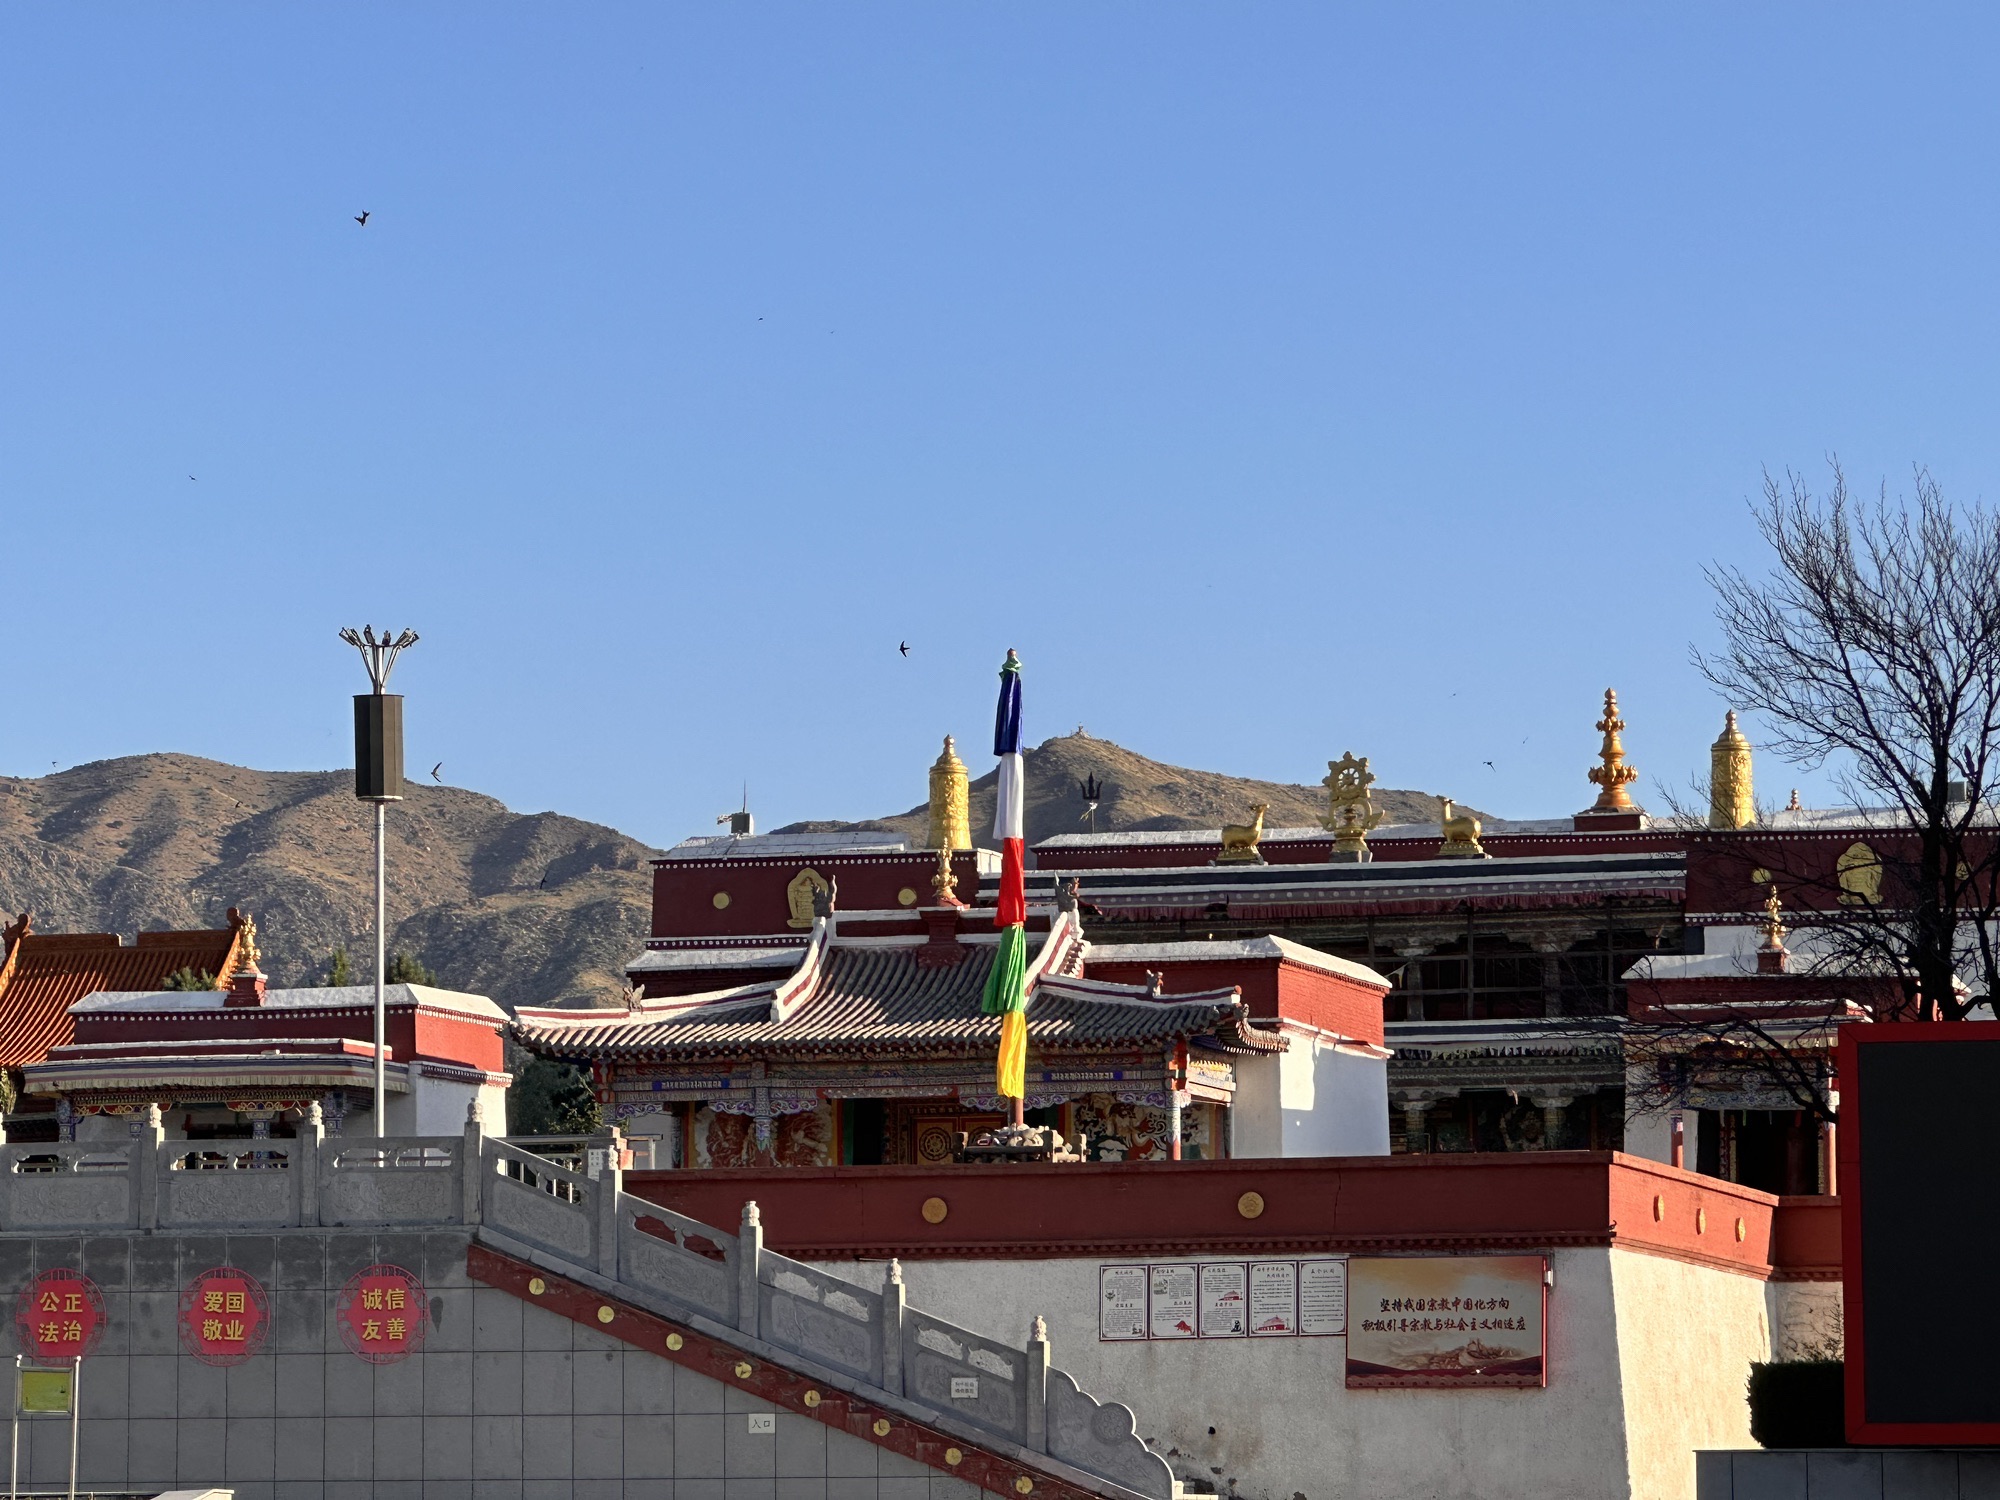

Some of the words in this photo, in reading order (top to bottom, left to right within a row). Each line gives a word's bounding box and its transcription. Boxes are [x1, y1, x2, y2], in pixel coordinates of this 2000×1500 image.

[39, 1291, 83, 1314] 公正
[203, 1291, 245, 1314] 爱国
[362, 1288, 405, 1311] 诚信
[1380, 1297, 1510, 1313] 坚持我国宗教中国化方向
[38, 1319, 83, 1343] 法治
[202, 1319, 245, 1341] 敬业
[362, 1318, 406, 1341] 友善
[1361, 1316, 1527, 1333] 积极引导宗教与社会主义相适应
[751, 1418, 771, 1429] 入口
